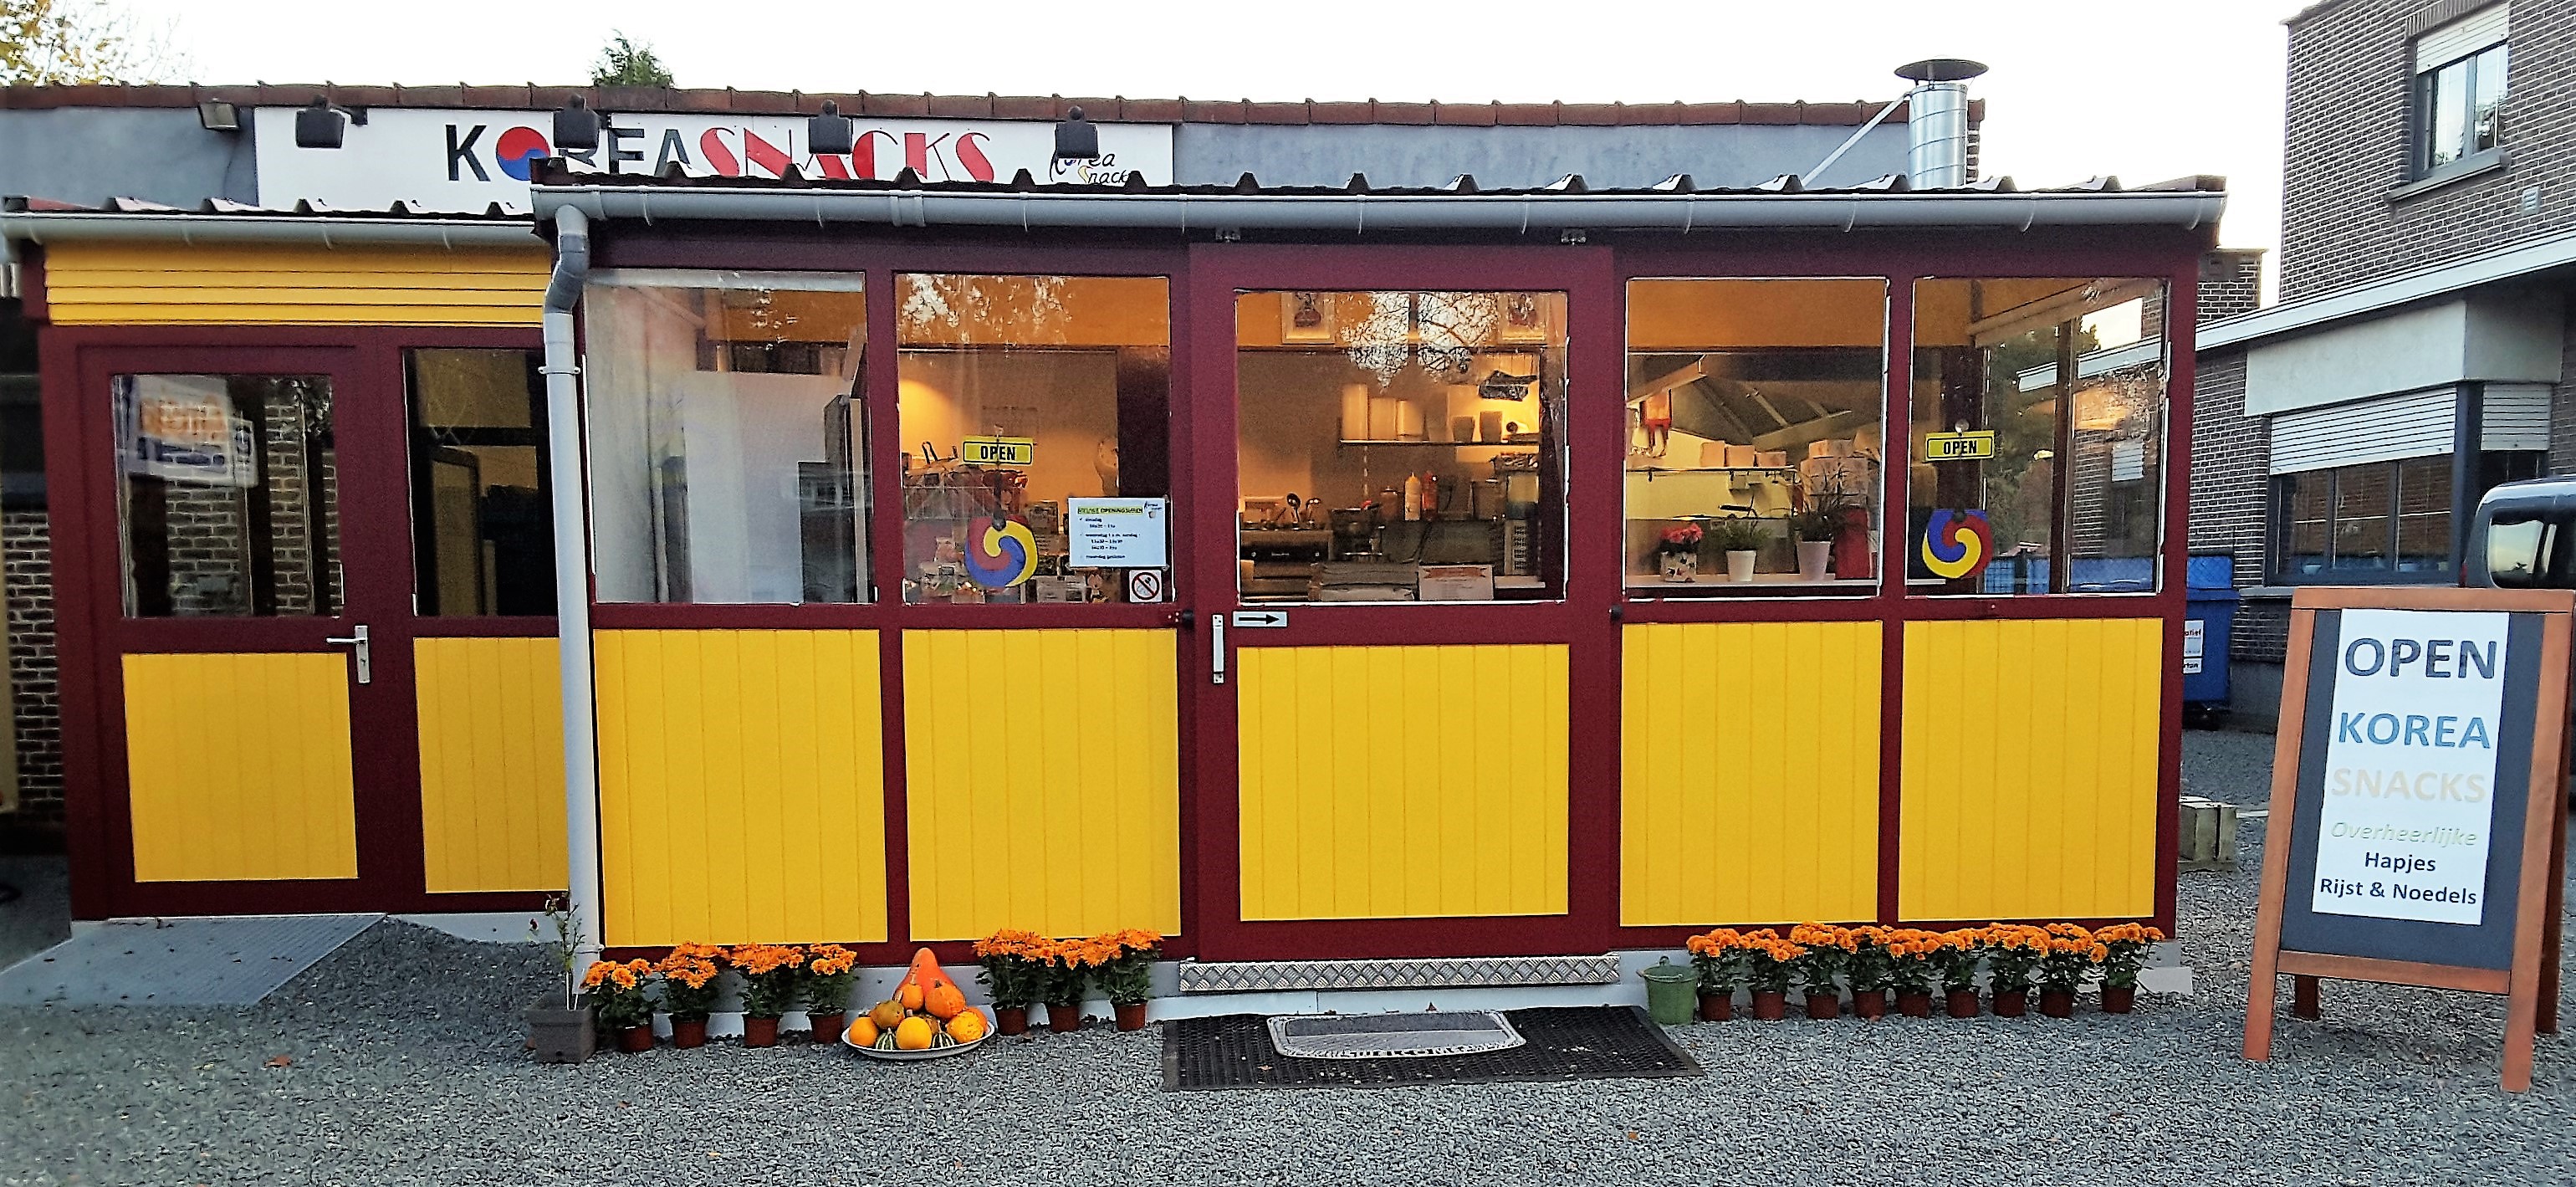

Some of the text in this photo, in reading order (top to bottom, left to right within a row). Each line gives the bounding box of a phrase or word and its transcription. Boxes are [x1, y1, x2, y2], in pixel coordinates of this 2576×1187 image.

[980, 445, 1015, 461] OPEN
[1943, 440, 1977, 455] OPEN
[2344, 637, 2497, 679] OPEN
[2338, 712, 2491, 750] KOREA
[2331, 767, 2487, 803] SNACKS
[2330, 821, 2478, 848] Overheerlijke
[2364, 852, 2436, 874] Hapjes
[2320, 877, 2477, 905] Rijst & Noedels
